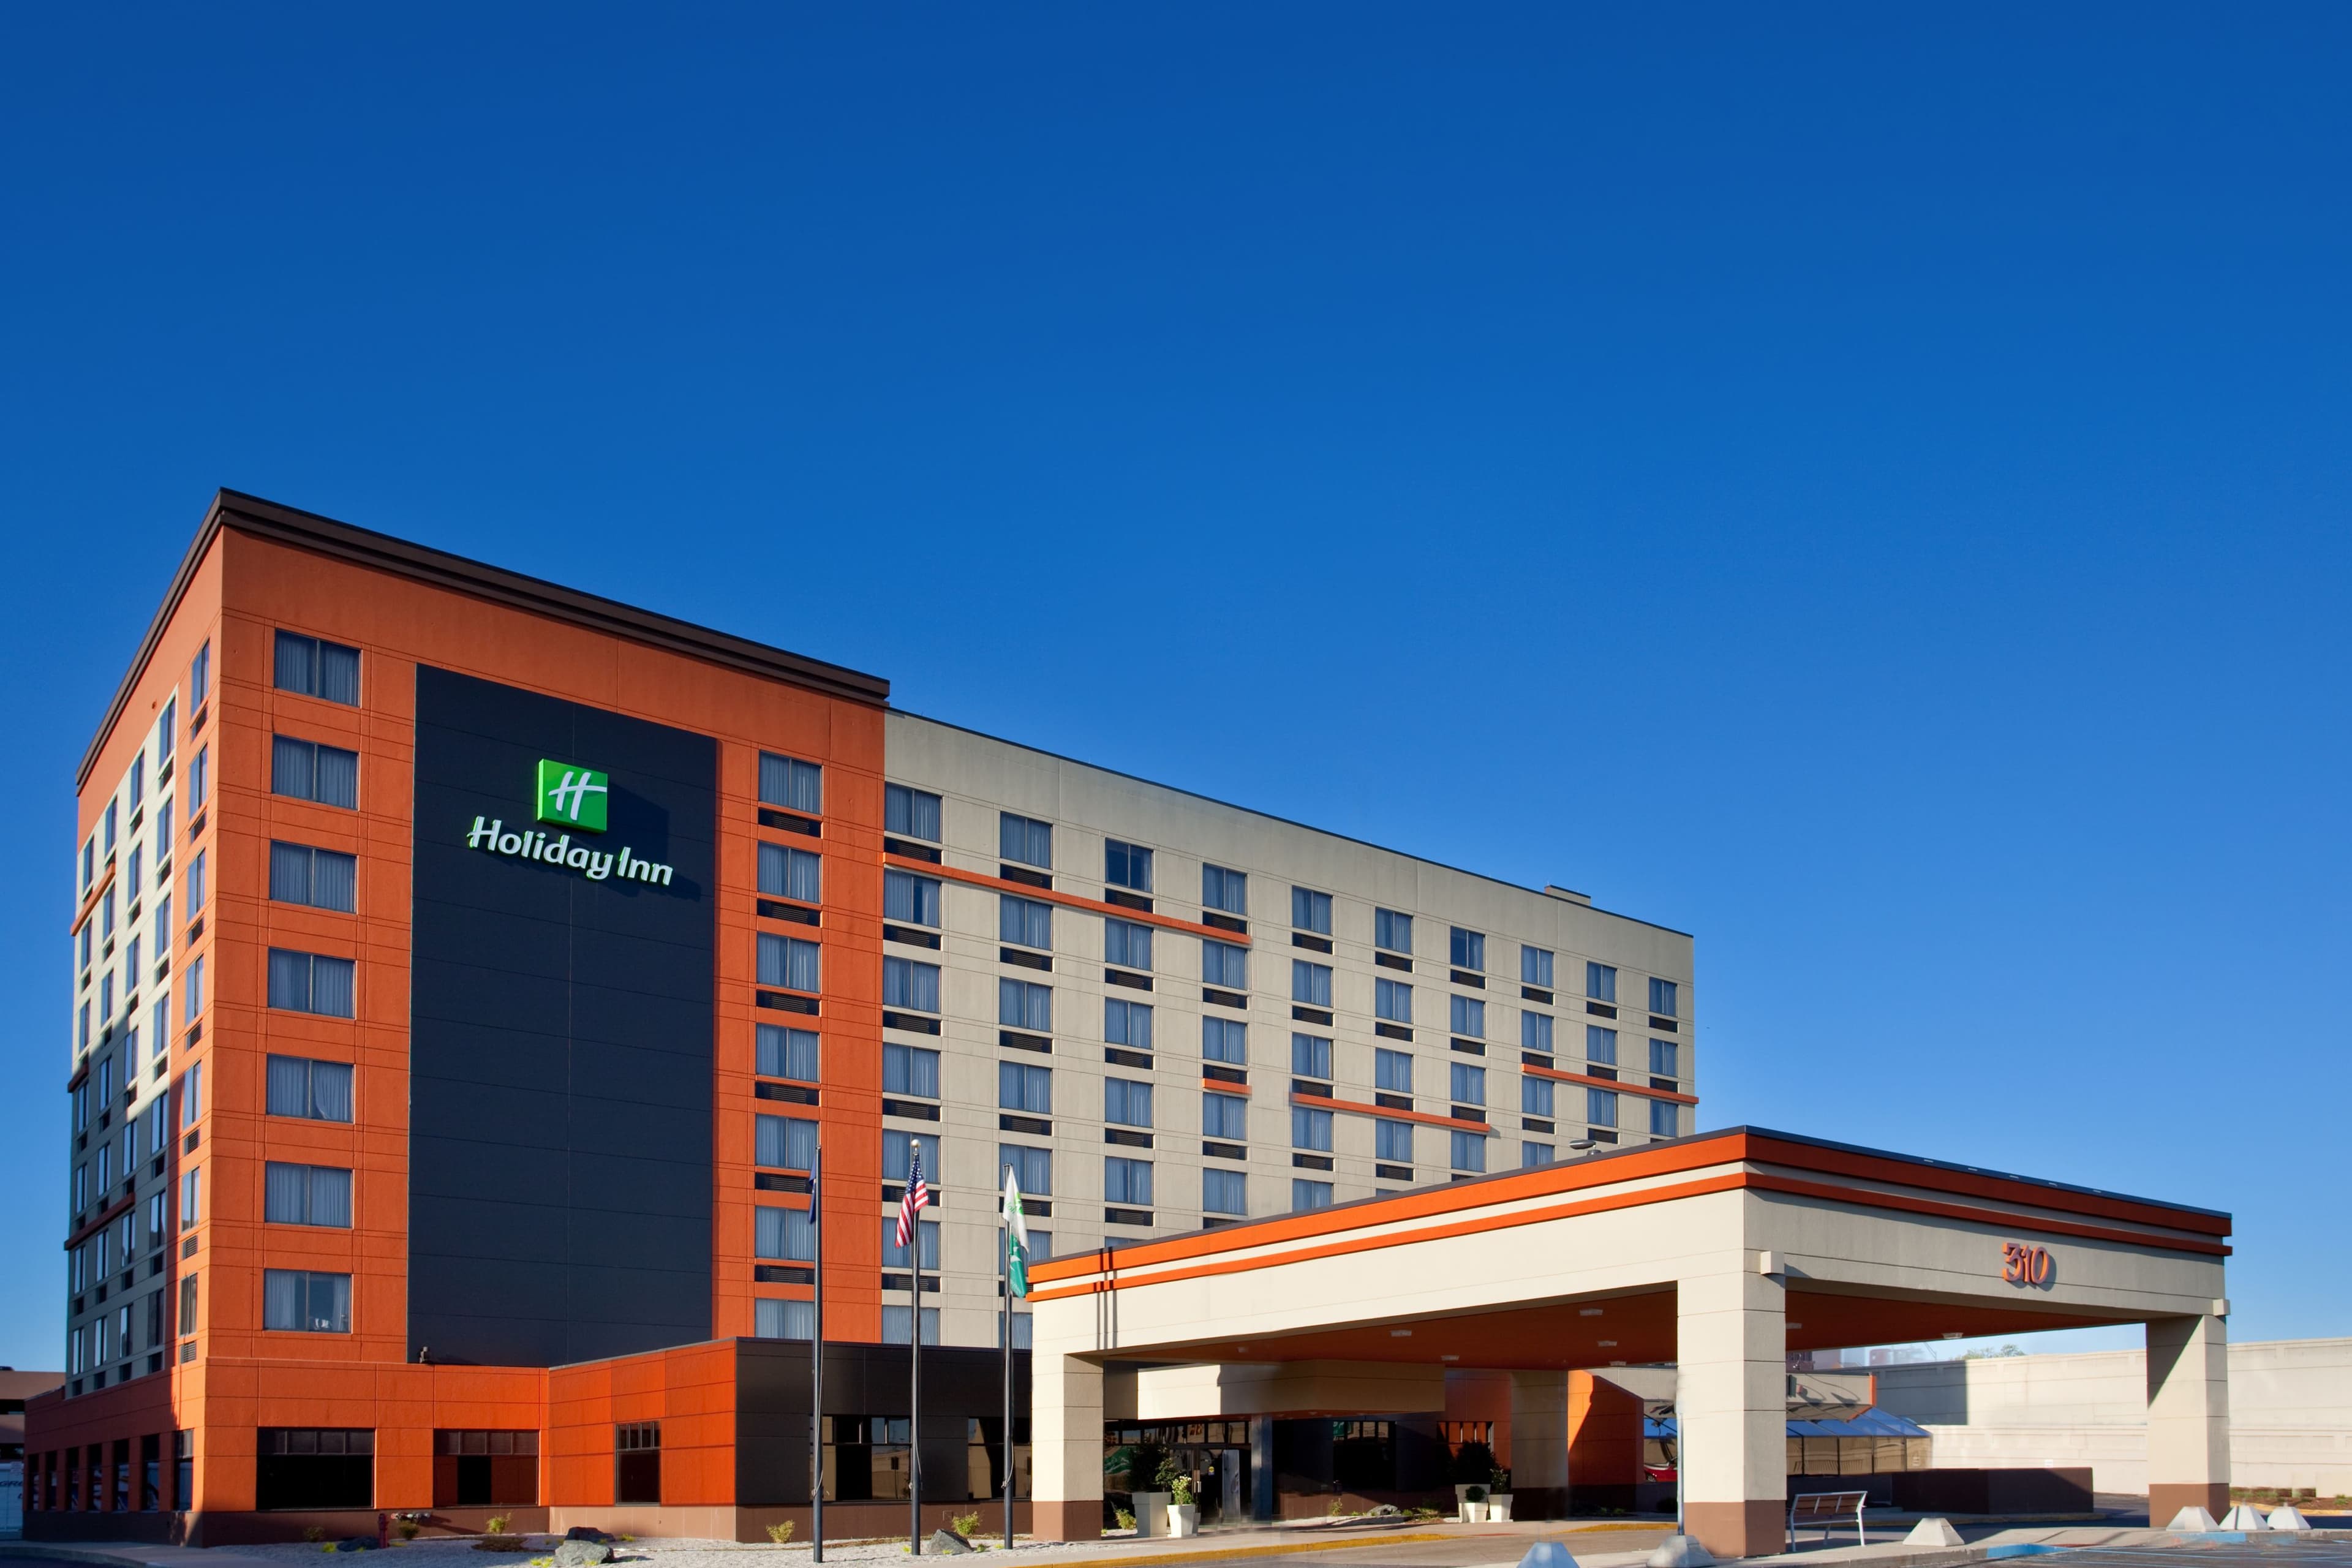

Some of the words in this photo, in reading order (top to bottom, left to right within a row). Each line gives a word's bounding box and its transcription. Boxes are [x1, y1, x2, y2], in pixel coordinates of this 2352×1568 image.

[467, 816, 613, 880] Holiday
[617, 846, 673, 886] Inn
[2002, 1242, 2049, 1284] 310
